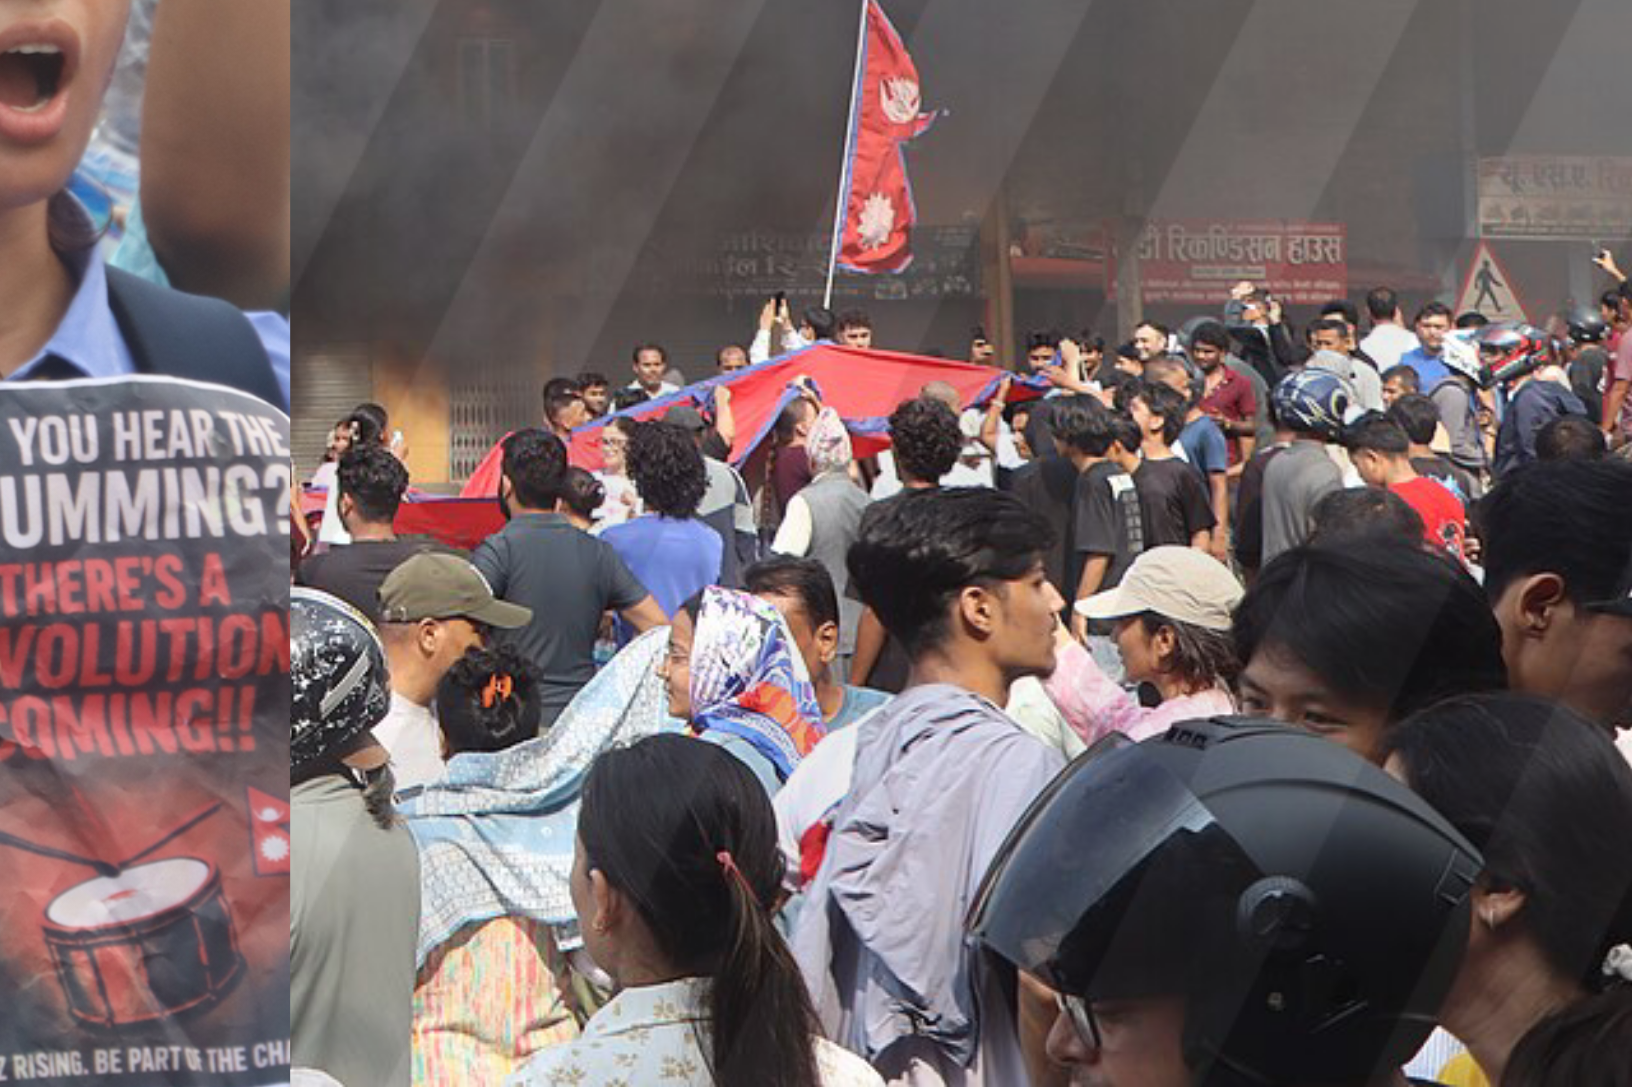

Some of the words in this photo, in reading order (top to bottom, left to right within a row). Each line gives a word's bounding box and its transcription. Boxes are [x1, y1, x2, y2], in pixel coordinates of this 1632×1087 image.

[8, 412, 98, 466] YOU
[113, 408, 218, 462] HEAR
[218, 410, 290, 457] THE
[199, 552, 230, 609] A
[12, 1050, 89, 1080] RISING.
[94, 1048, 122, 1075] BE
[128, 1046, 182, 1072] PART
[205, 1046, 248, 1073] THE
